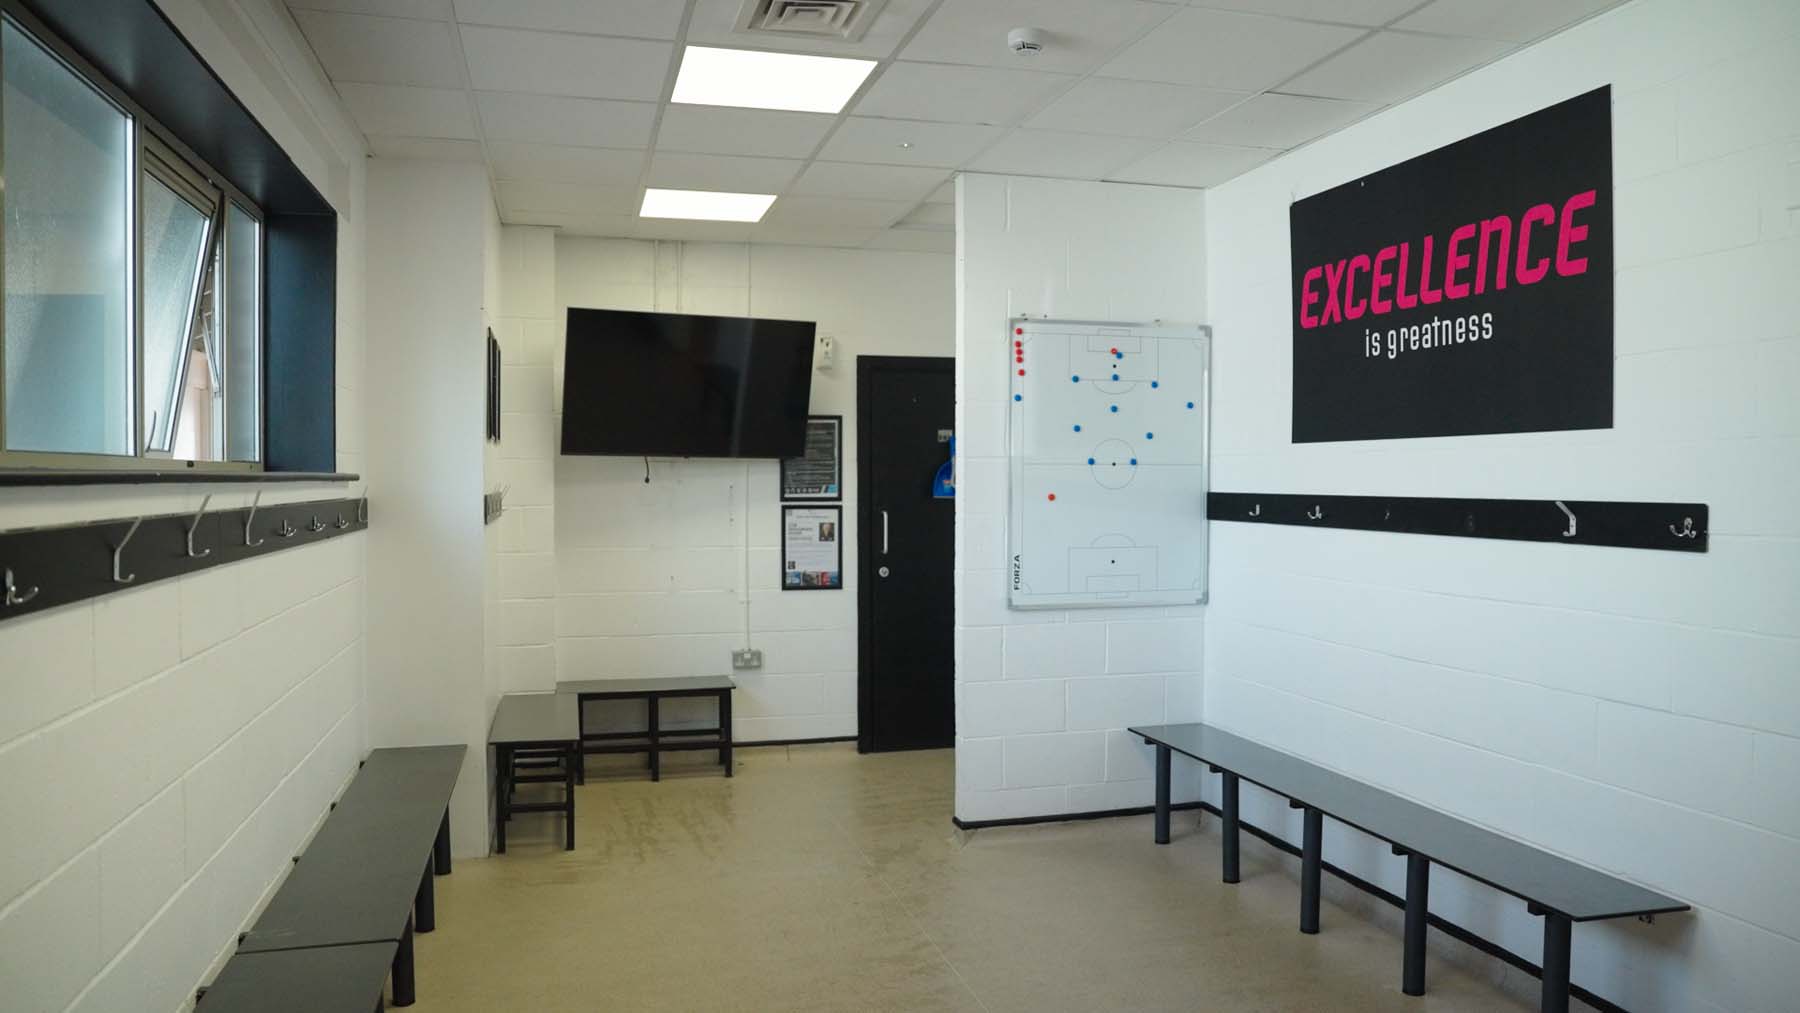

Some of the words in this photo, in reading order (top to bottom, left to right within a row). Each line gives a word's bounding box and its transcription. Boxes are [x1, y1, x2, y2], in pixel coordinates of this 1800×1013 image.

[1300, 189, 1597, 329] EXCELLENCE
[1365, 328, 1381, 358] is
[1387, 312, 1493, 360] greatness
[1013, 554, 1021, 591] FORZA
